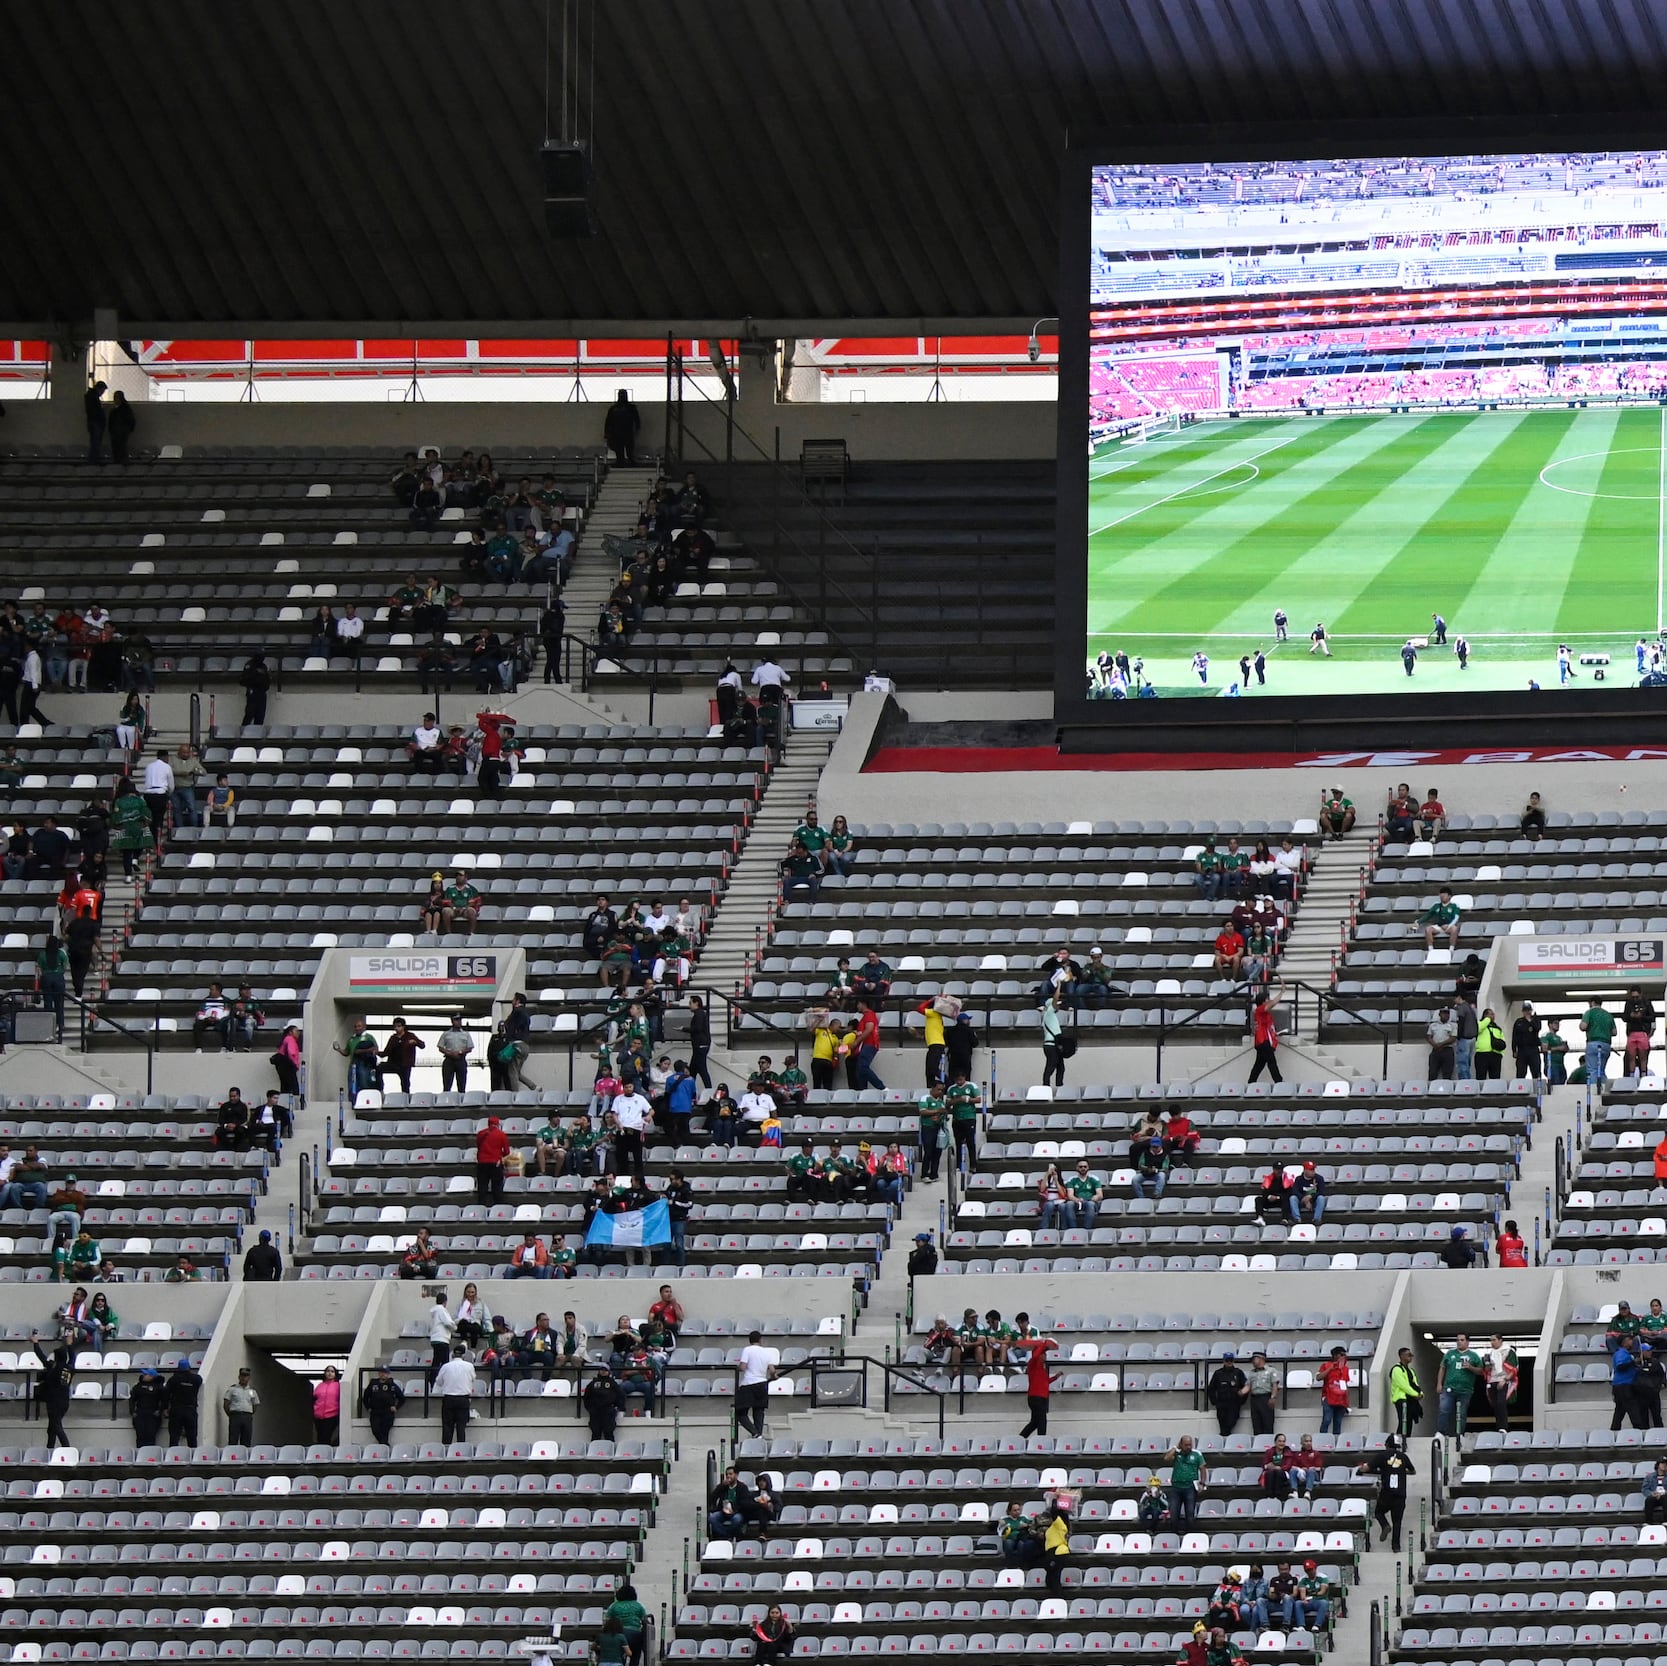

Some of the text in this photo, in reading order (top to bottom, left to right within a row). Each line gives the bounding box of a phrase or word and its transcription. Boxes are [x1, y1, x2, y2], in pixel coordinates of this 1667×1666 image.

[1537, 942, 1655, 961] SALIDA 65
[368, 958, 488, 976] SALIDA 66
